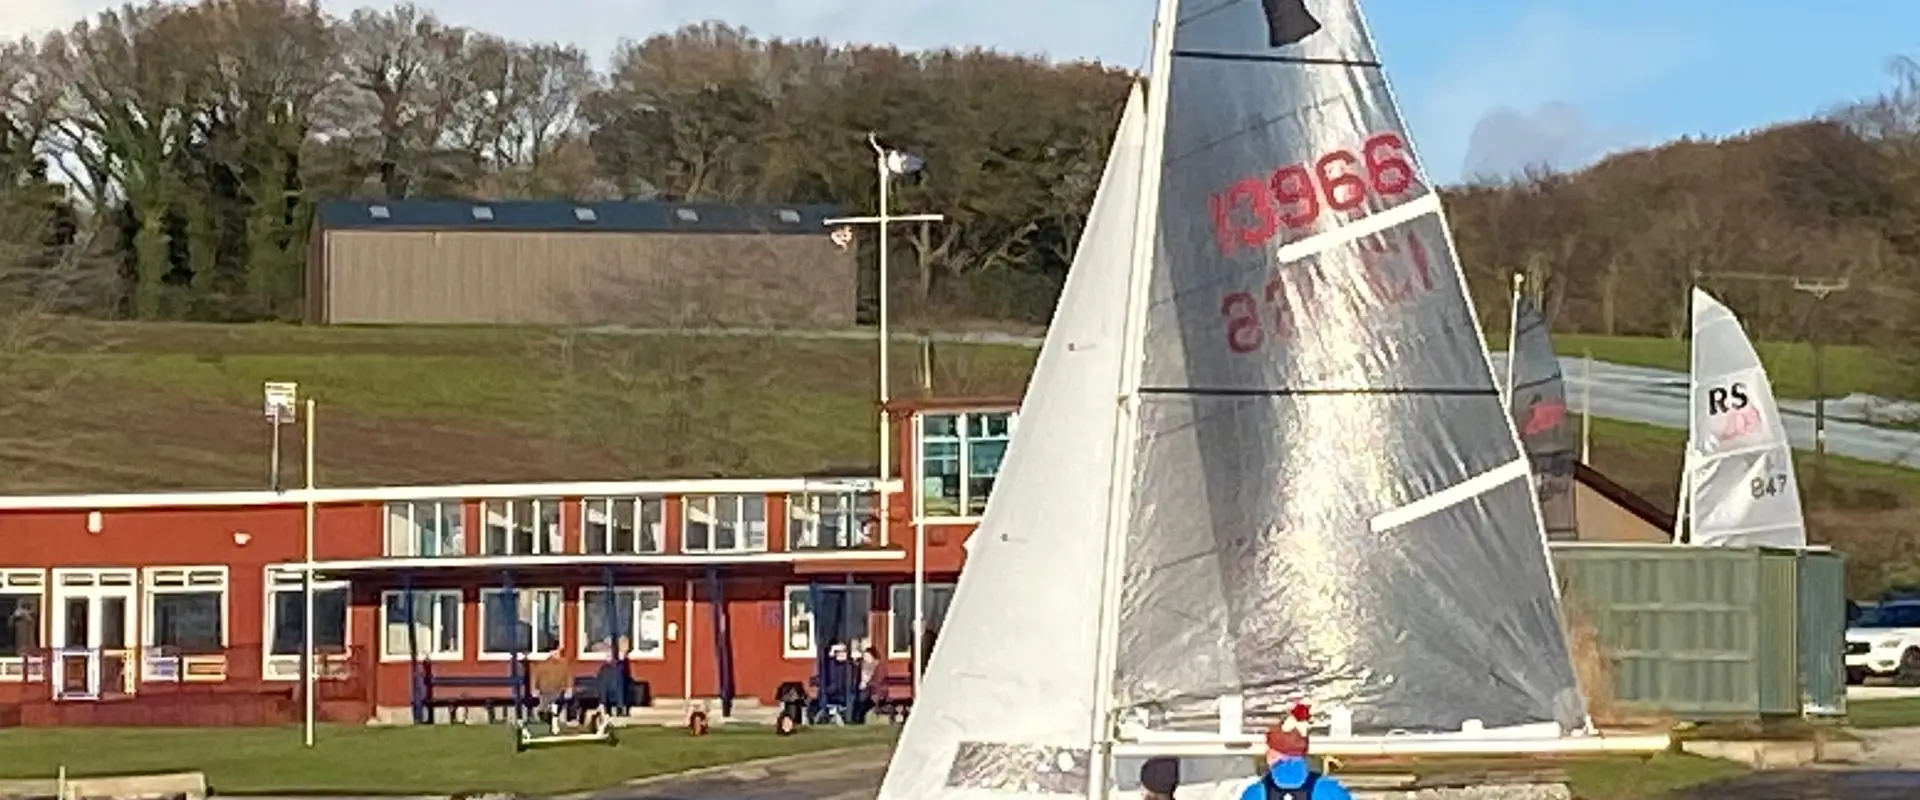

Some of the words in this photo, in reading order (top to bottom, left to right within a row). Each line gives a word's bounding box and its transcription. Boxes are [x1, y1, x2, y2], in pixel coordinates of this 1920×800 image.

[1210, 132, 1413, 256] 13966
[1708, 382, 1748, 415] RS
[1751, 474, 1787, 500] 847
